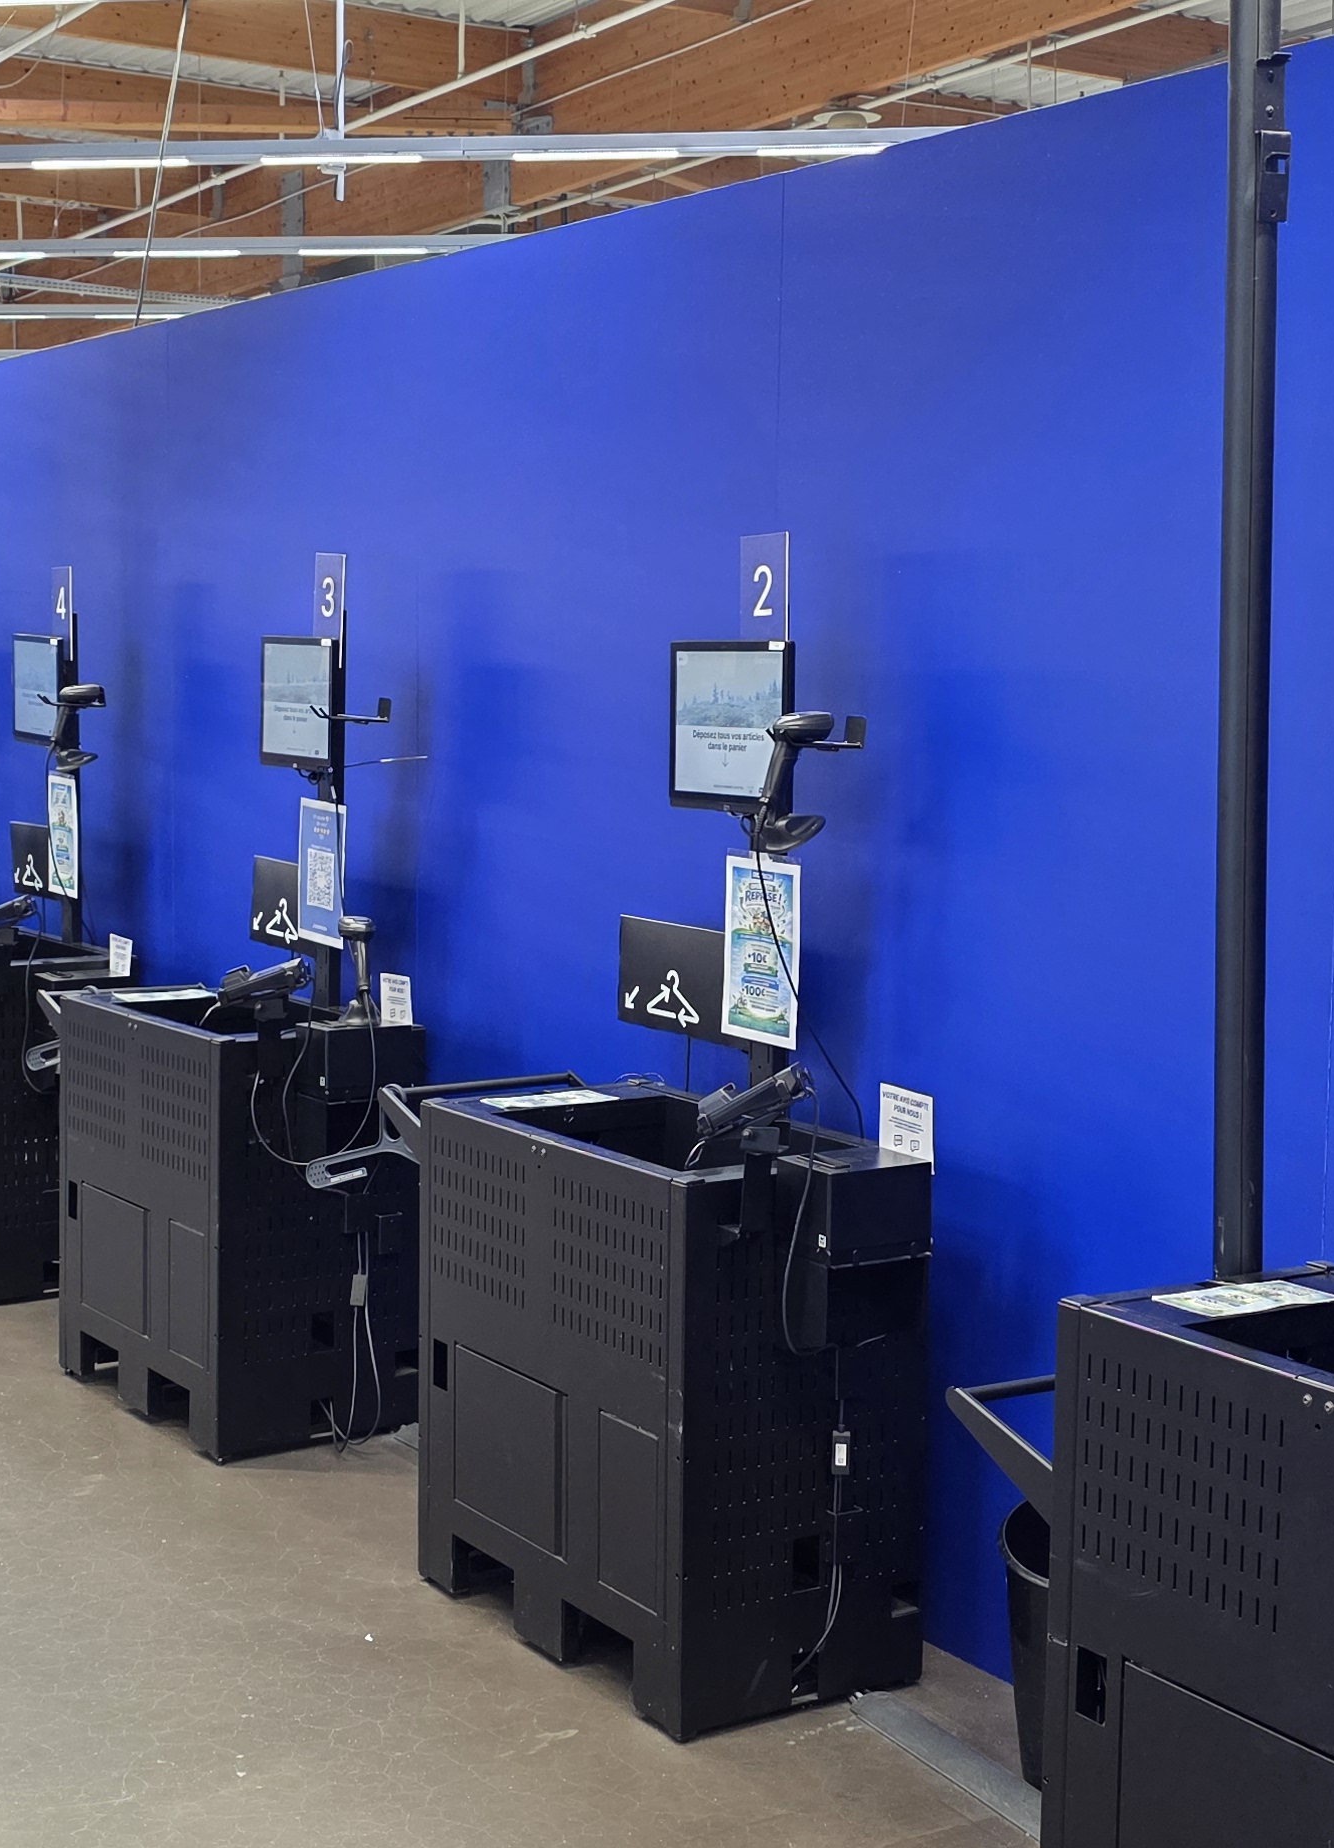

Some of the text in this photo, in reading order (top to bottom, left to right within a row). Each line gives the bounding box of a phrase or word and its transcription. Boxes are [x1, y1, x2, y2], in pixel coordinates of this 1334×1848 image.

[56, 586, 66, 620] 4
[321, 576, 335, 618] 3
[753, 565, 773, 617] 2
